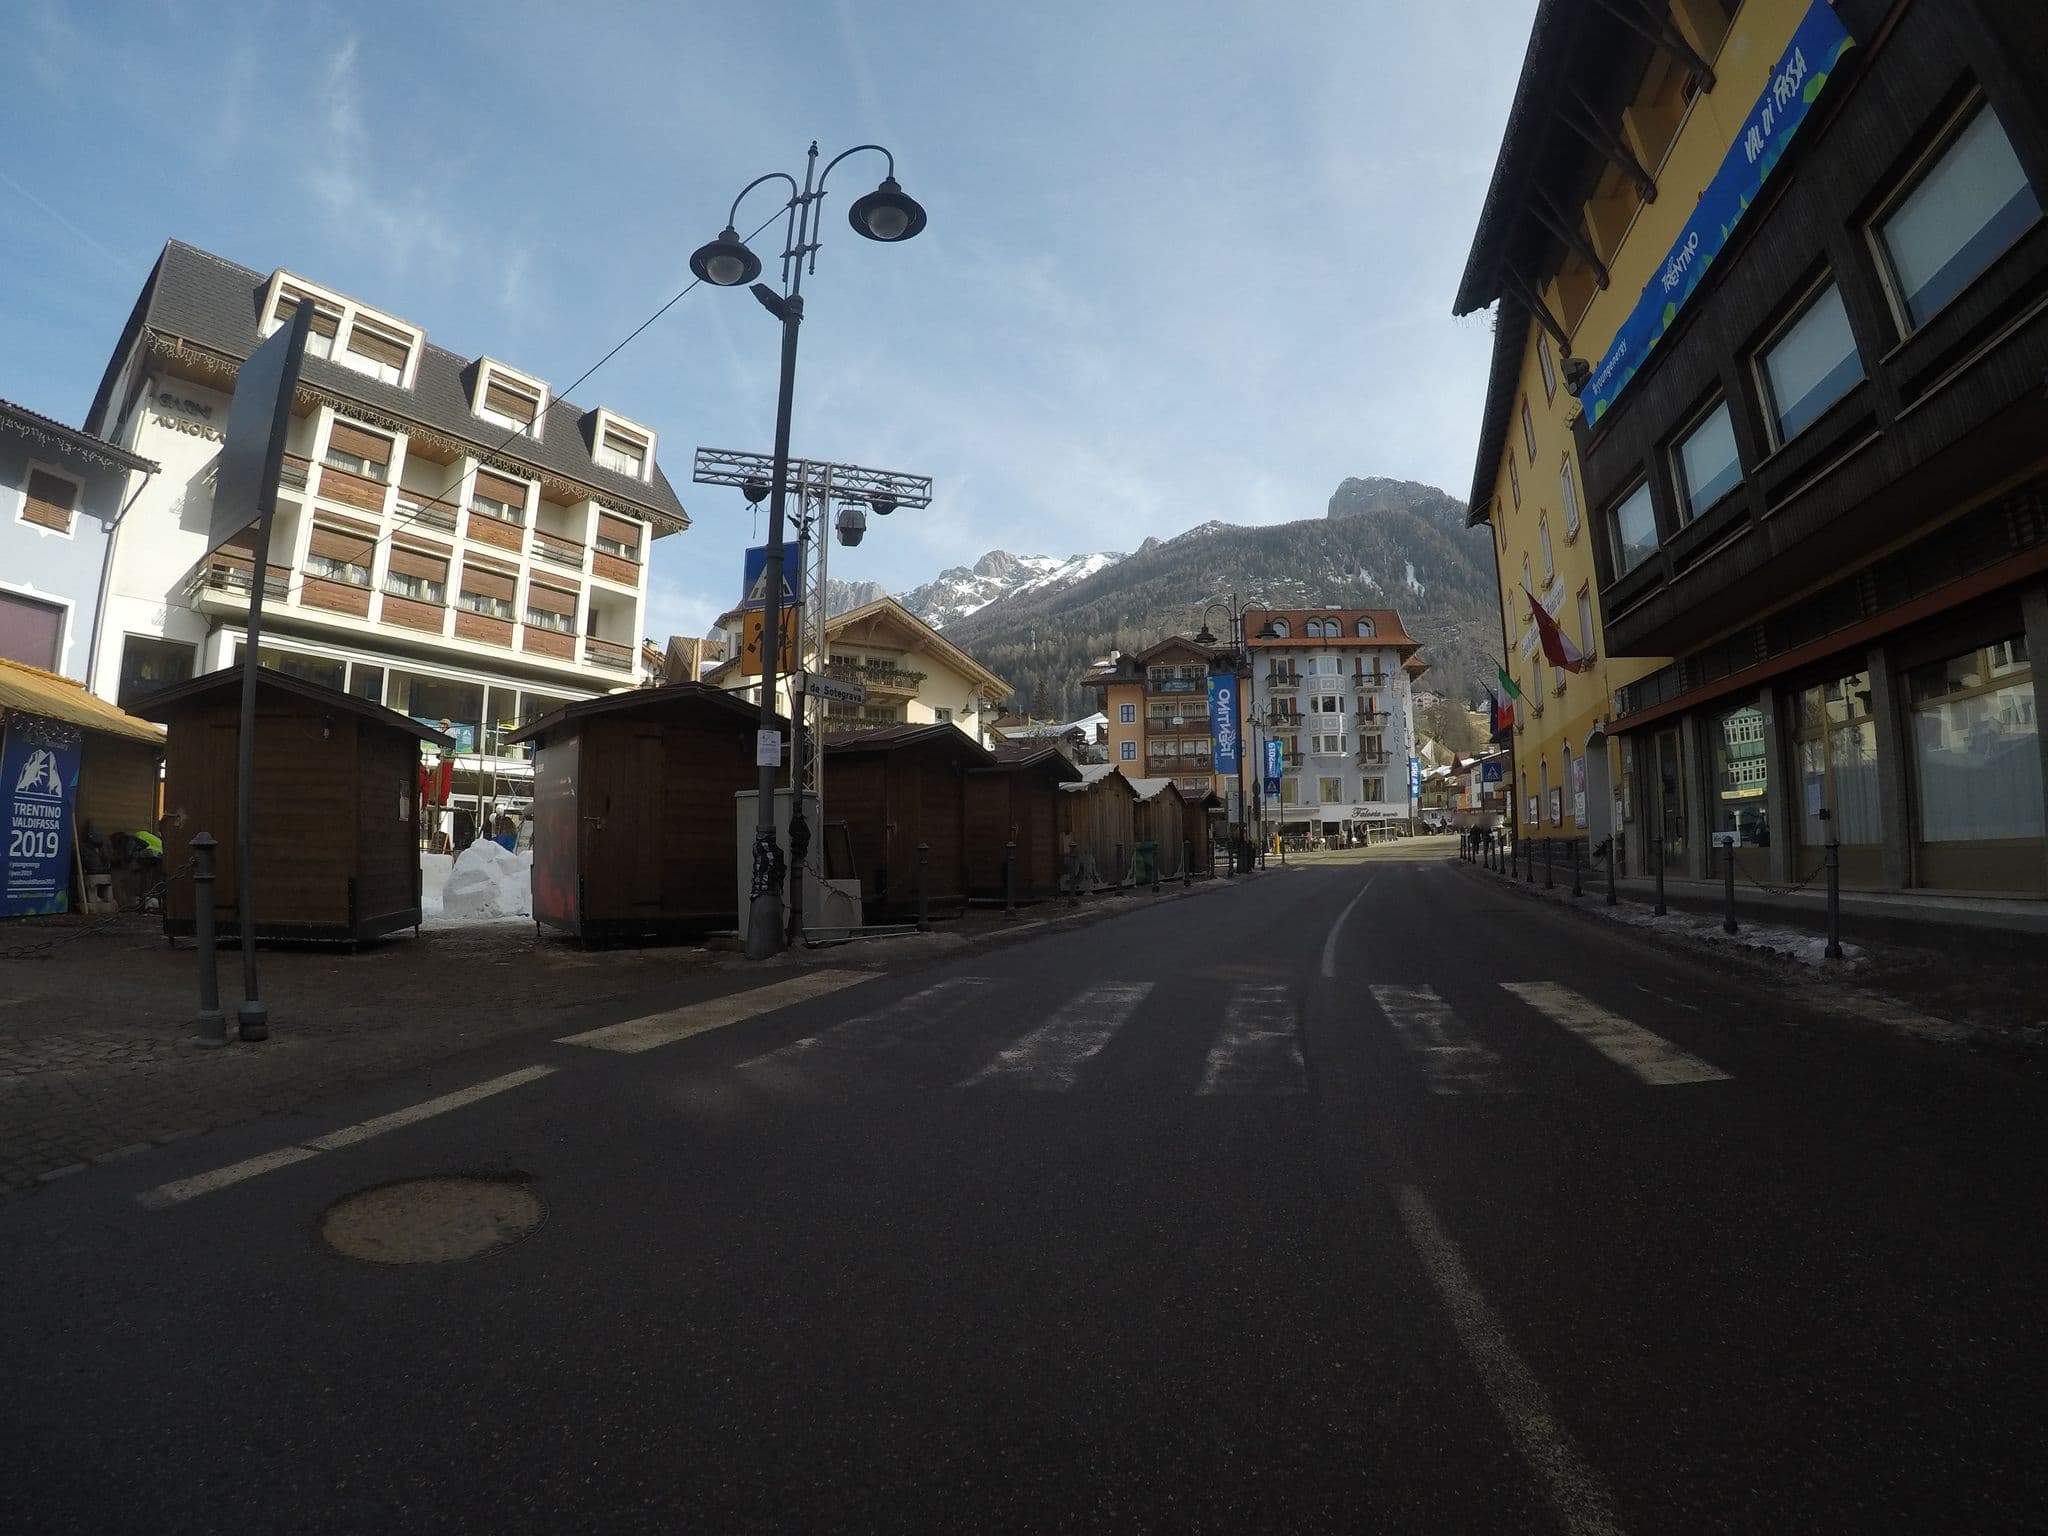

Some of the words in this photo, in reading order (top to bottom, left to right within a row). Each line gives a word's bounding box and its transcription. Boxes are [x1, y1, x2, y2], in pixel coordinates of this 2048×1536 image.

[1744, 124, 1764, 164] VAL
[1773, 46, 1807, 113] FASSA
[1661, 231, 1699, 294] TRENTINO
[151, 416, 226, 444] AURORA
[810, 682, 820, 694] de
[823, 685, 862, 702] Sotegrava
[12, 817, 60, 830] VALDIFASSA
[13, 802, 62, 819] TRENTINO
[9, 829, 59, 858] 2019
